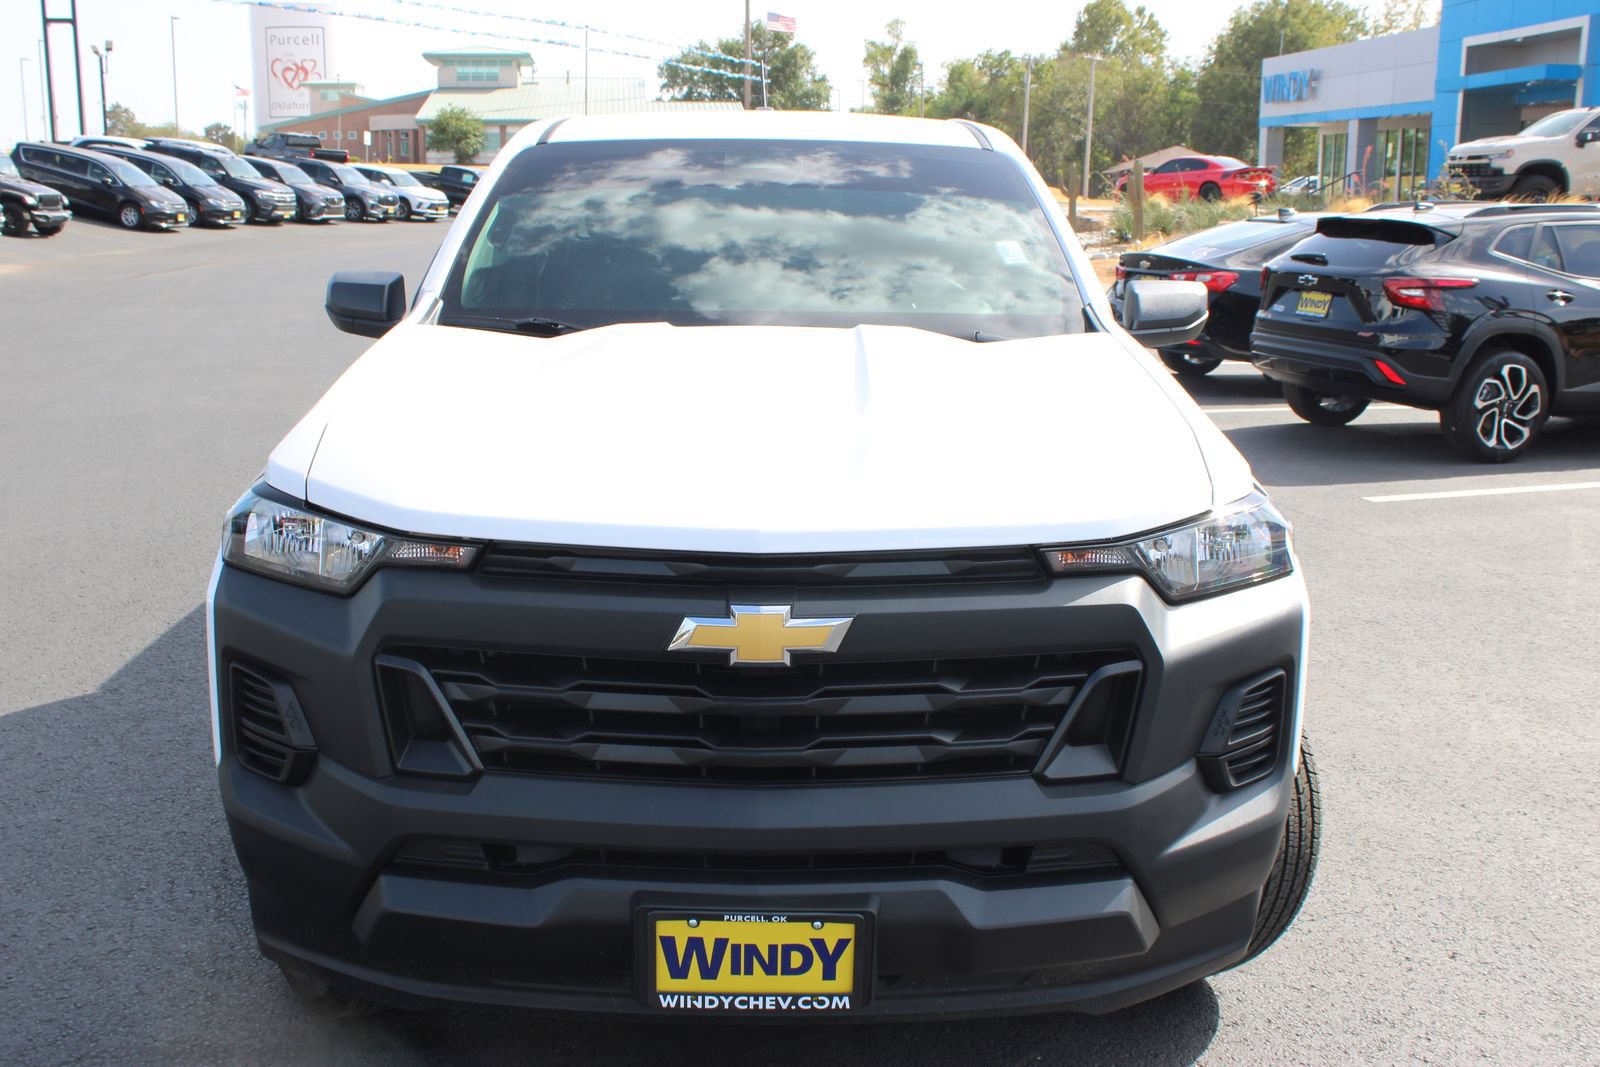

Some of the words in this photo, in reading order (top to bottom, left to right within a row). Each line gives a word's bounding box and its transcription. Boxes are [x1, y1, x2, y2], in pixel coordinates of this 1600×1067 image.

[270, 33, 320, 46] Purcell
[1263, 69, 1314, 104] WINDY
[1300, 297, 1330, 310] WINDY
[723, 914, 769, 923] PURCELL,
[771, 915, 788, 923] OK
[658, 935, 852, 981] WINDY
[658, 994, 850, 1010] WINDYCHEV.COM
